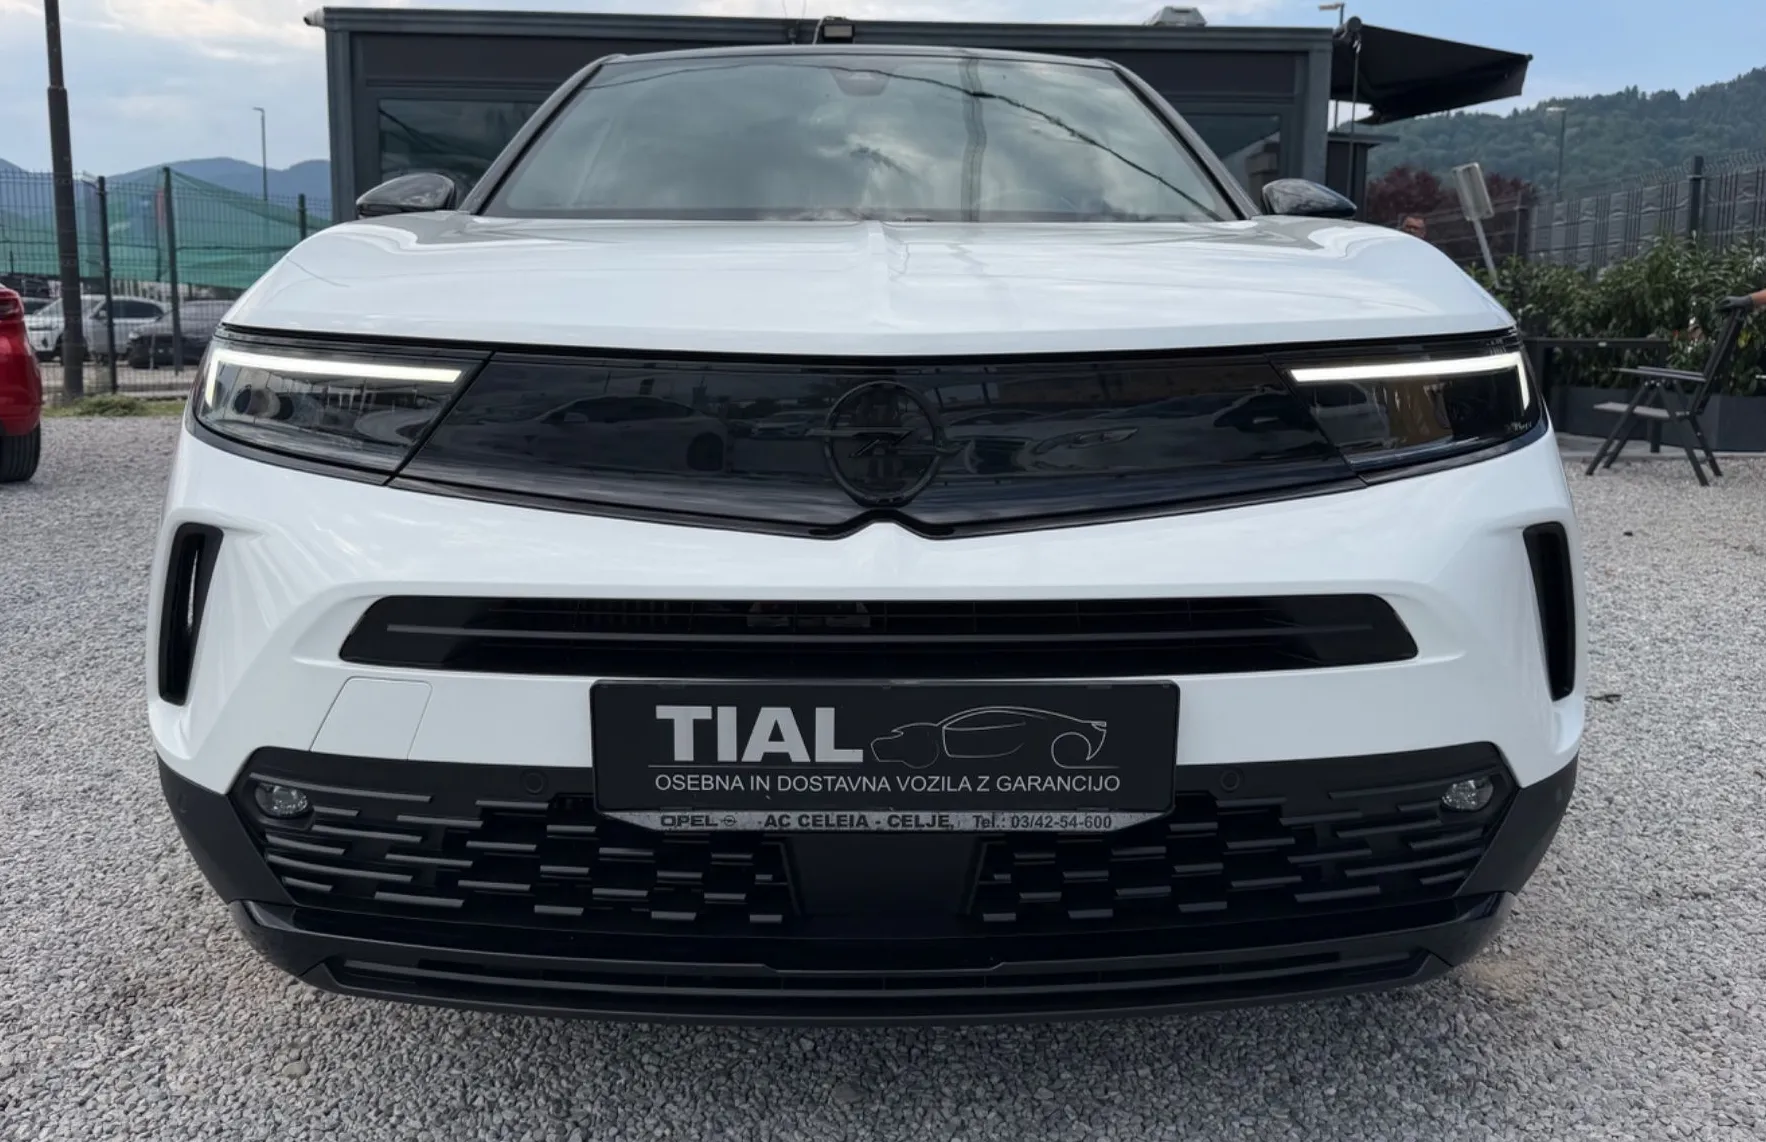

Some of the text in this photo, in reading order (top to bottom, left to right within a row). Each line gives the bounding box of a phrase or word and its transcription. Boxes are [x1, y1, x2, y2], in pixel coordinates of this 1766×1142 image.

[656, 705, 863, 762] TIAL
[655, 774, 1120, 792] OSEBNA IN DOSTAVNA VOZILA Z GARANCIJO
[660, 814, 718, 827] OPEL
[764, 814, 791, 827] AC
[798, 814, 869, 828] CELEIA
[972, 813, 1005, 829] Tel.:
[1011, 814, 1112, 829] 03/42-54-600
